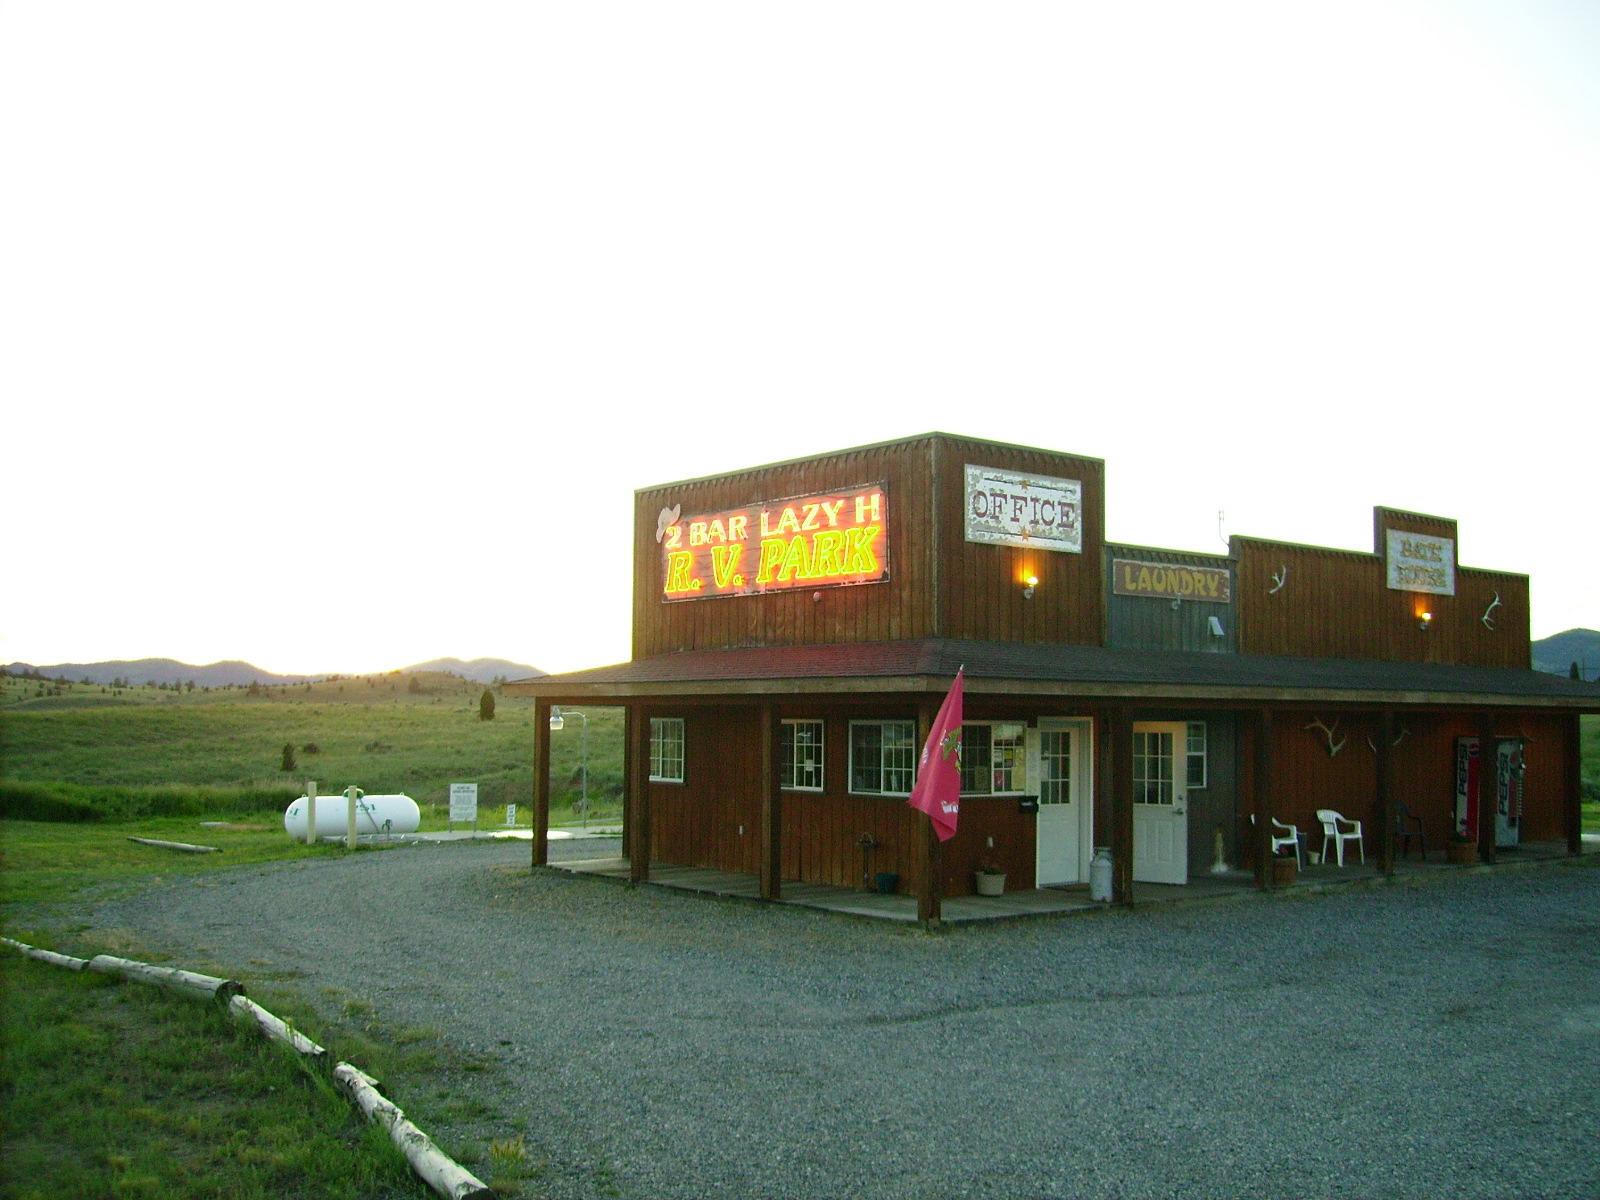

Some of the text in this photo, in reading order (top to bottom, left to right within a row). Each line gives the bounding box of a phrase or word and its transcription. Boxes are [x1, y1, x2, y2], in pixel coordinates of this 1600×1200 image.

[664, 493, 881, 549] 2 BAR LAZY H
[973, 489, 1075, 529] OFFICE
[664, 525, 880, 593] R. V. PARK
[1124, 564, 1219, 598] LAUNDRY
